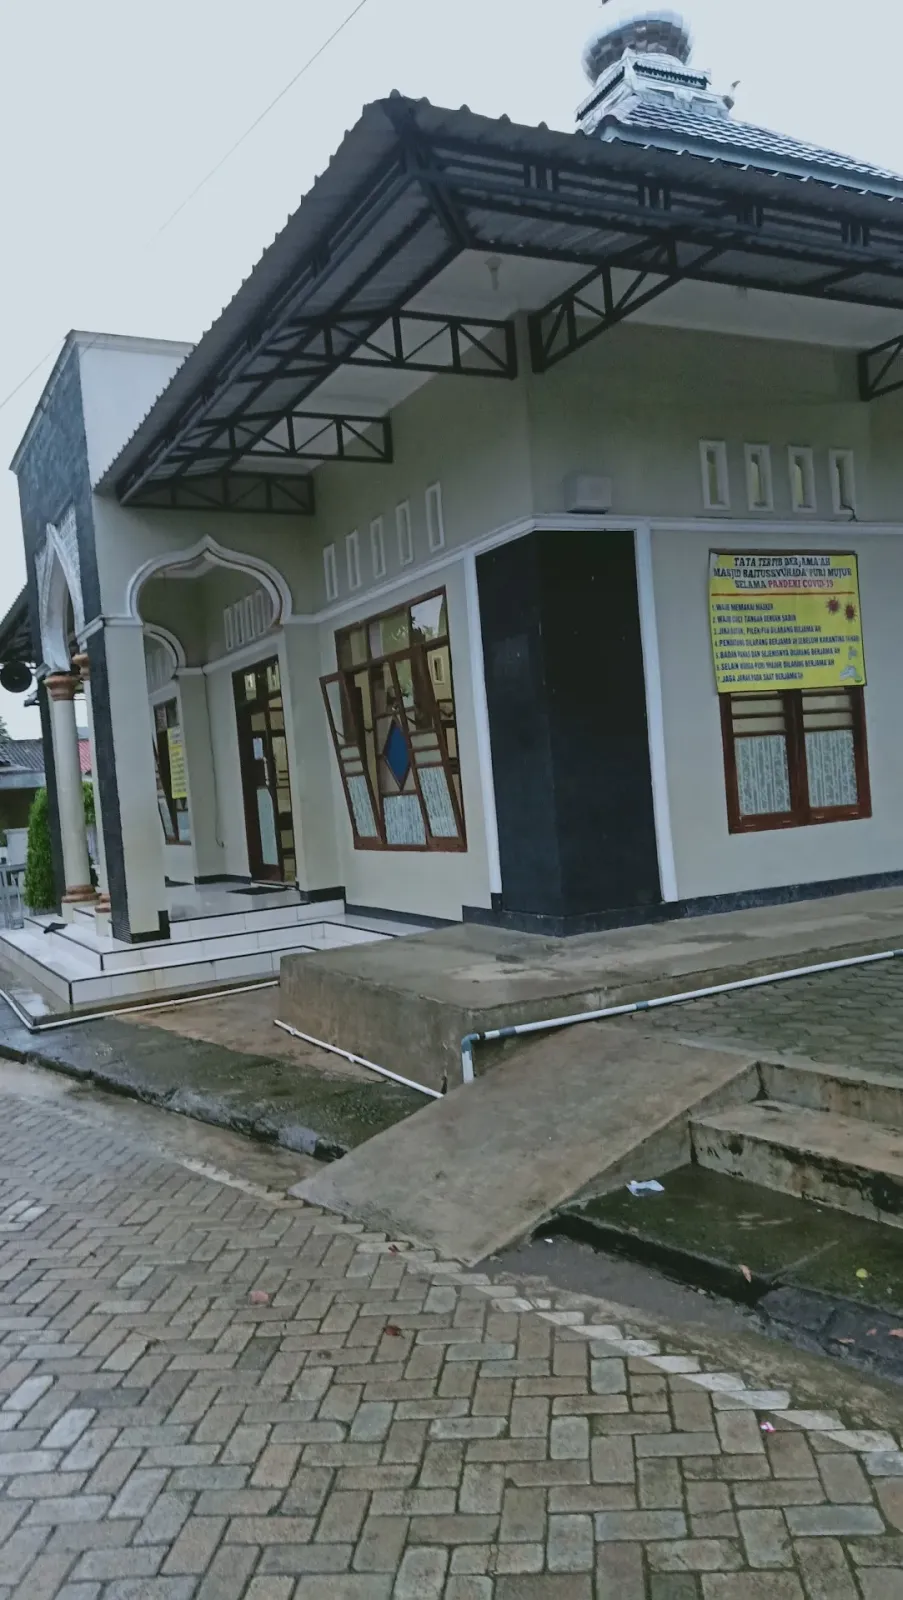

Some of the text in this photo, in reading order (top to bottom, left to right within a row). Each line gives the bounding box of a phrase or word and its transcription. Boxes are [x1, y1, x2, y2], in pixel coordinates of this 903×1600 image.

[734, 557, 756, 566] TATA
[713, 568, 741, 579] MASJID
[735, 580, 766, 589] SELAMA
[802, 580, 834, 588] COVID-19
